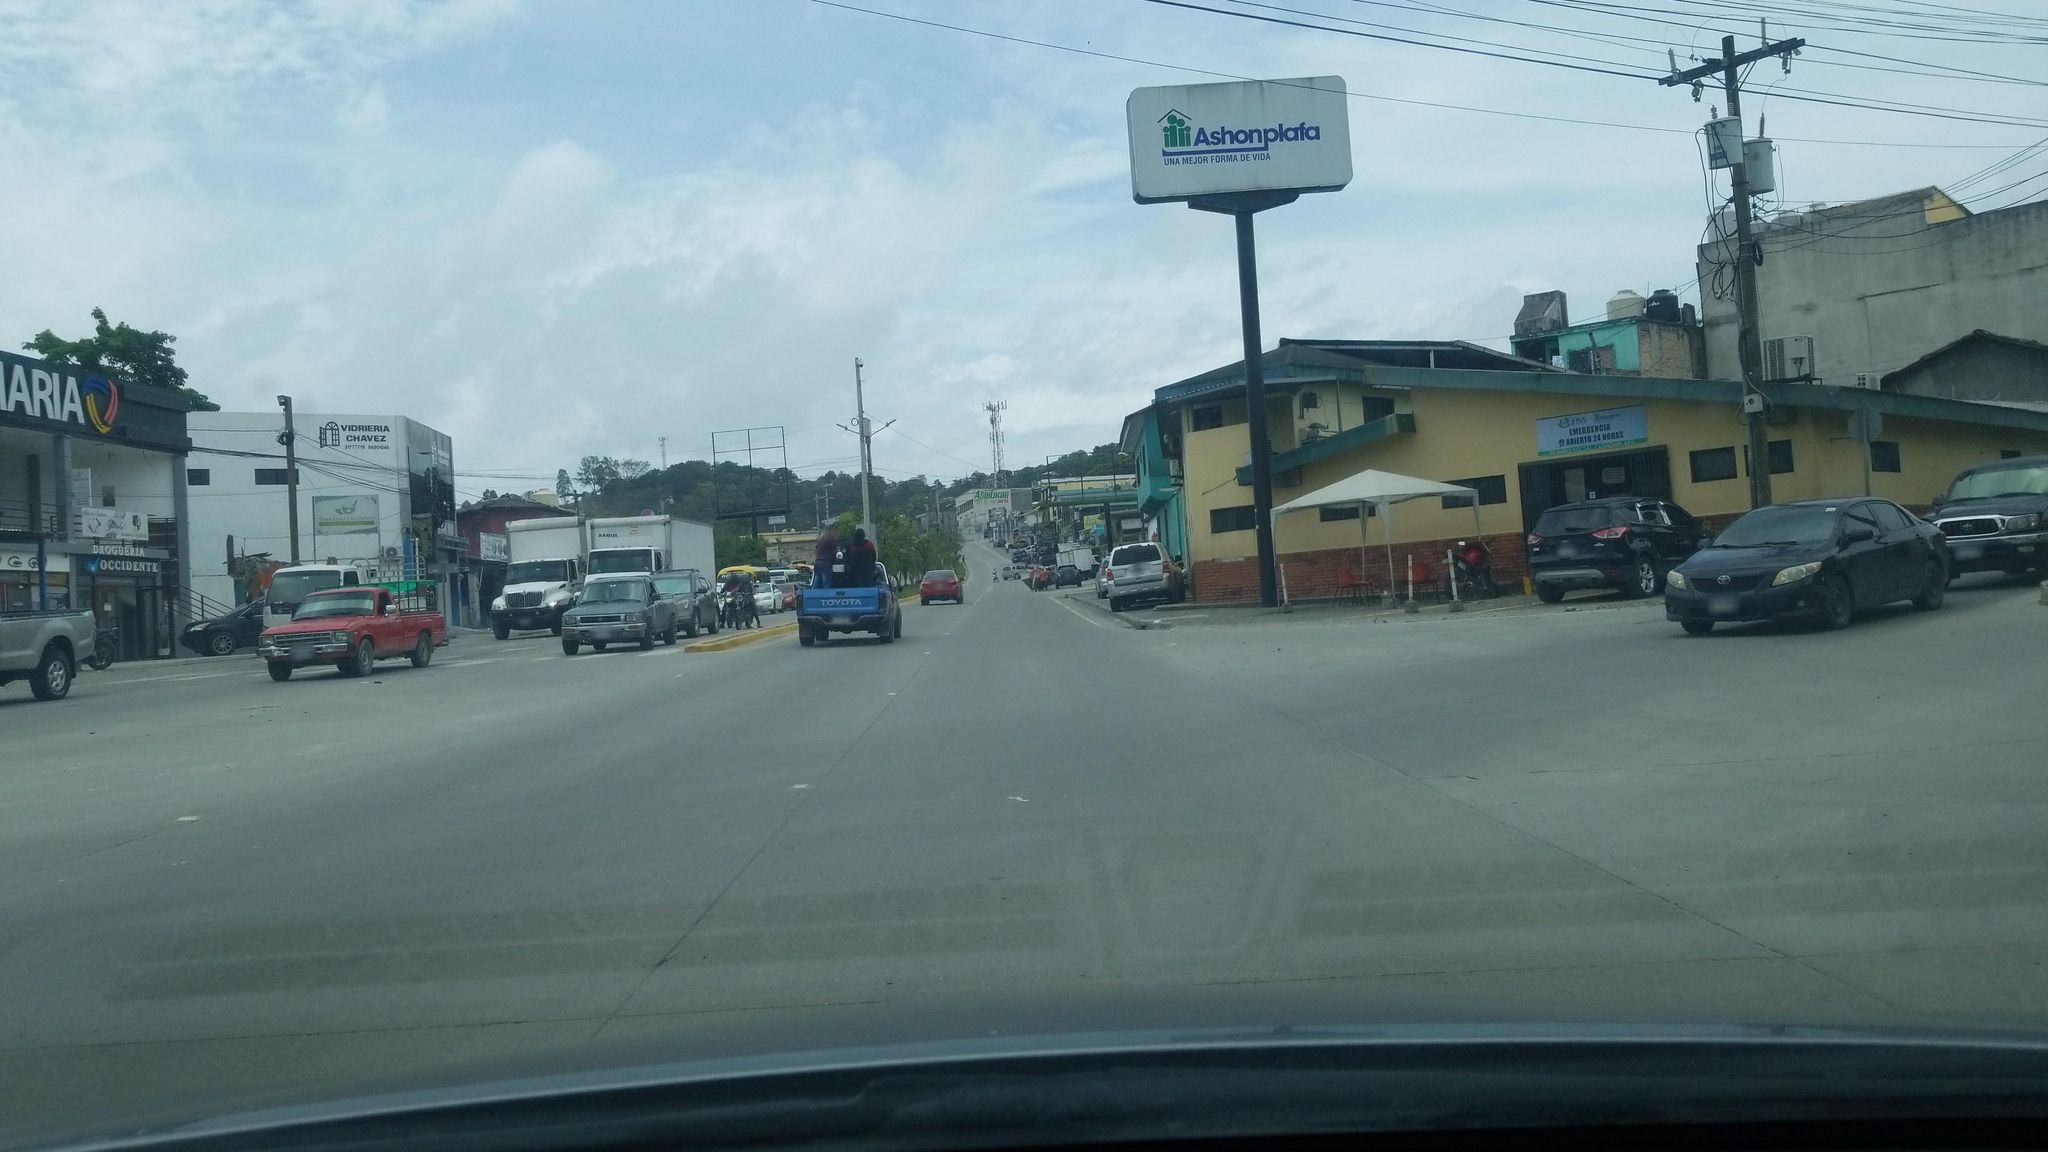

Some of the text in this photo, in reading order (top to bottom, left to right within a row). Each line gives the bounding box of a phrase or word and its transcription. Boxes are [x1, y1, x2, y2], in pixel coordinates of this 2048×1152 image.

[1194, 121, 1320, 150] Ashonplafa
[1164, 152, 1270, 166] UNA MEJOR FORMA DE VIDA
[0, 361, 86, 425] ARIA
[340, 424, 390, 432] VIDRIERIA
[1569, 423, 1611, 436] EMERGENCIA
[1566, 431, 1624, 446] ABIERTO 24 HORAS
[100, 560, 159, 573] OCCIDENTE
